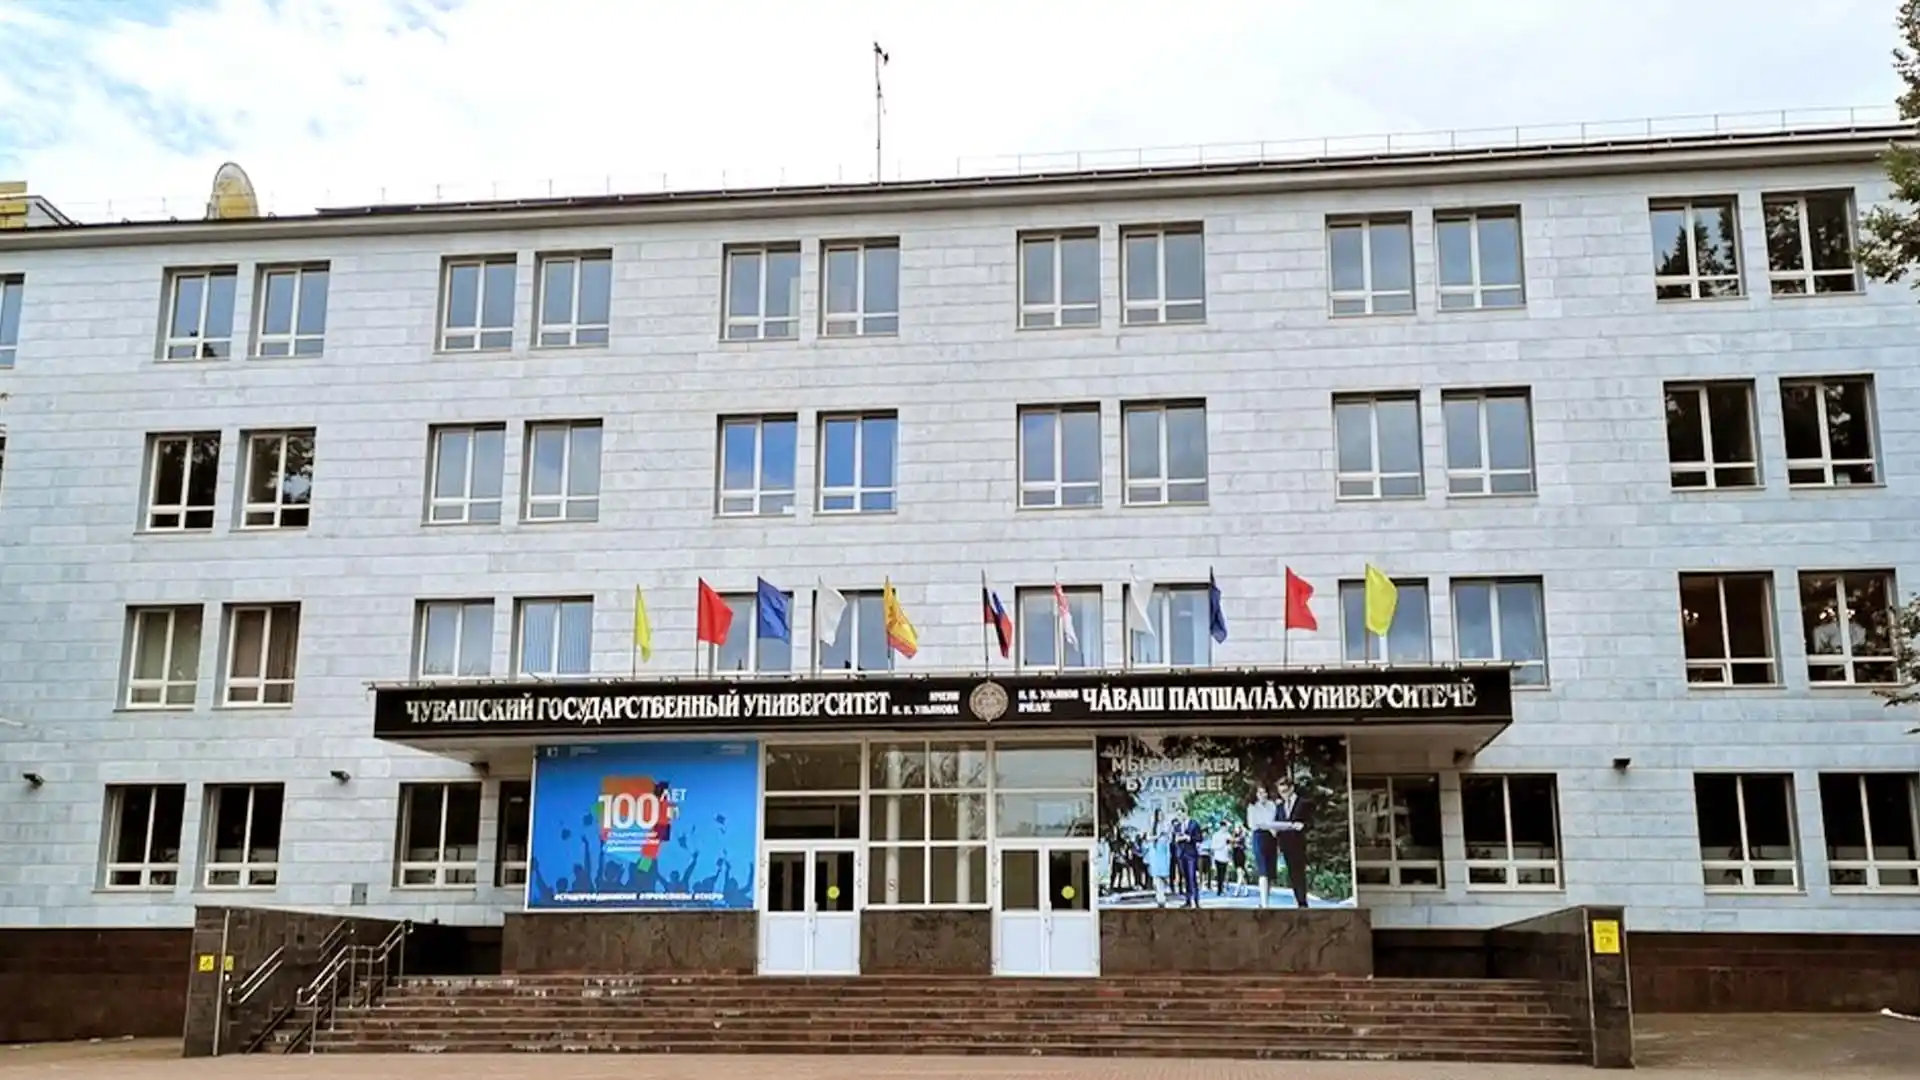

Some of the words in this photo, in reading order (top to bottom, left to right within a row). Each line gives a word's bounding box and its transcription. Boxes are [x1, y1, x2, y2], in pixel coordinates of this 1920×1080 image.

[405, 692, 534, 723] ЧУВАШСКИЙ
[536, 689, 740, 725] ГОСУДАРСТВЕННЫЙ
[743, 691, 891, 717] УНИВЕРСИТЕТ
[1111, 756, 1146, 773] МЫ
[1125, 774, 1223, 793] БУДУЩЕЕ!
[660, 787, 687, 802] ЛЕТ
[598, 792, 660, 830] 100
